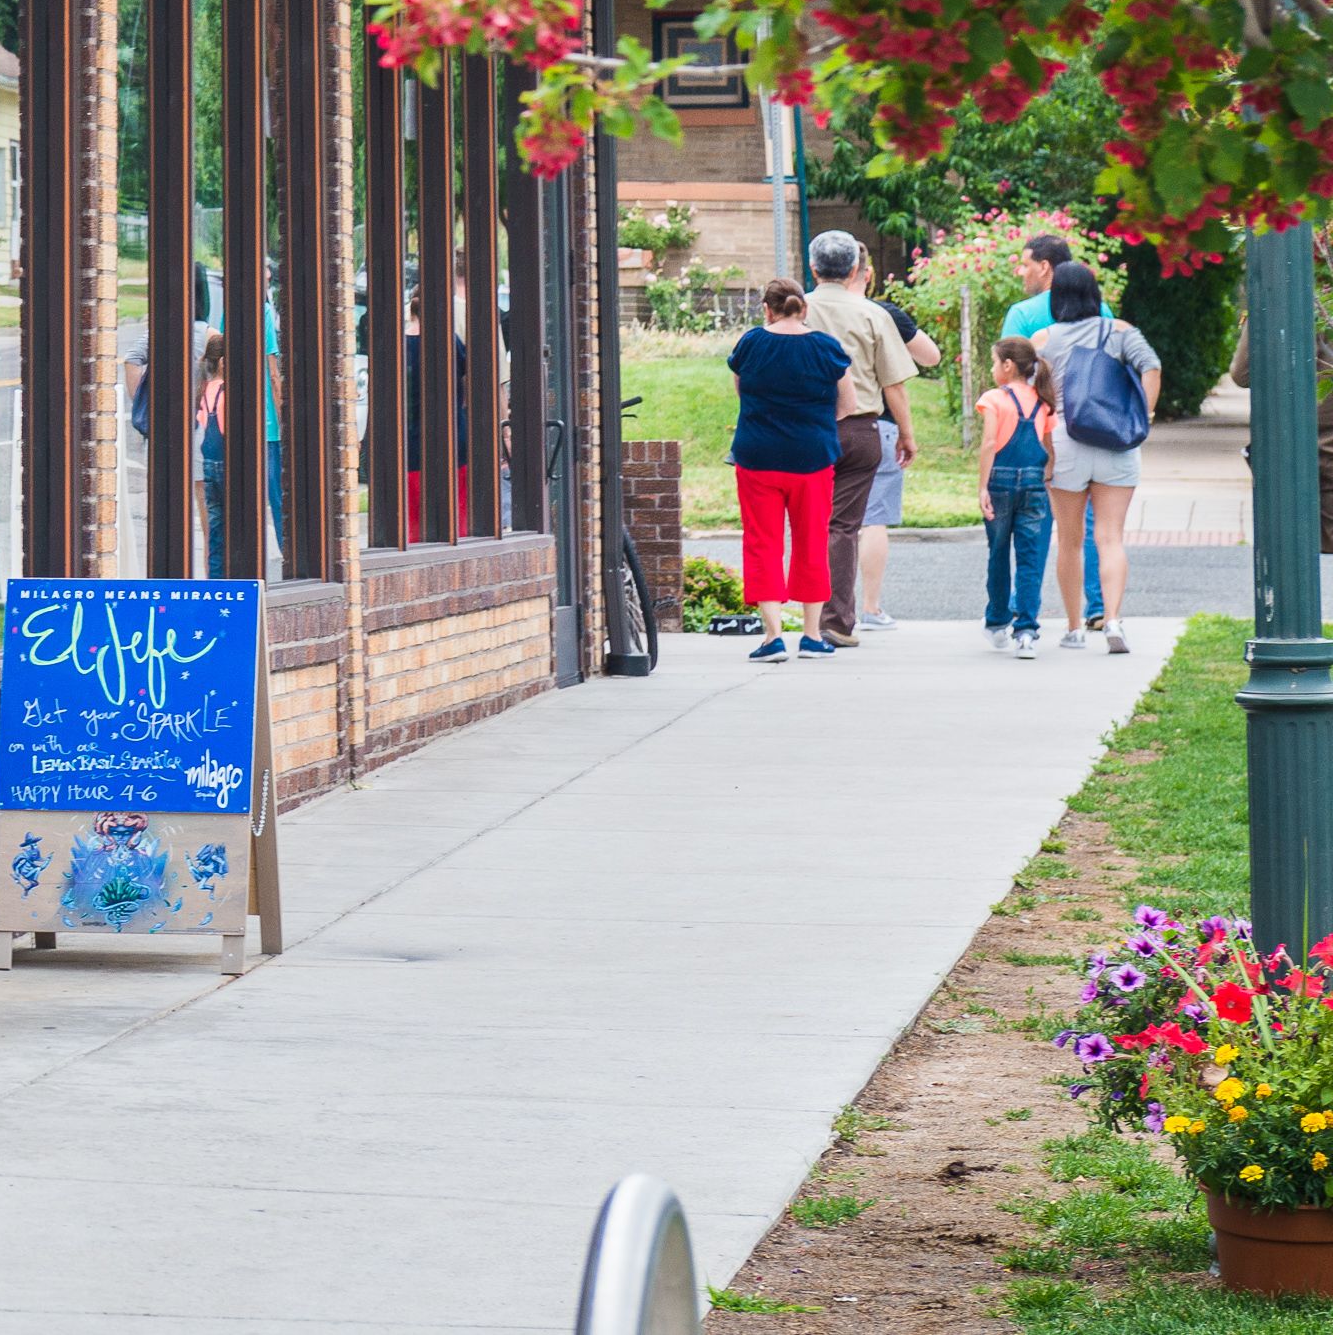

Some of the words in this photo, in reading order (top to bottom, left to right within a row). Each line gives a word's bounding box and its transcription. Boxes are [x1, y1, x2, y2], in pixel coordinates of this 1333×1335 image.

[20, 590, 95, 600] MILAGRO
[105, 590, 161, 600] MEANS
[171, 591, 246, 601] MIRACLE
[21, 601, 97, 675] El
[96, 602, 218, 708] Jefe
[22, 698, 68, 728] Get
[79, 710, 121, 737] your
[120, 693, 233, 742] SPARKLE
[8, 742, 25, 753] on
[31, 734, 72, 755] with
[11, 785, 61, 803] HAPPY
[119, 785, 158, 802] 4-6
[184, 748, 244, 809] milagro
